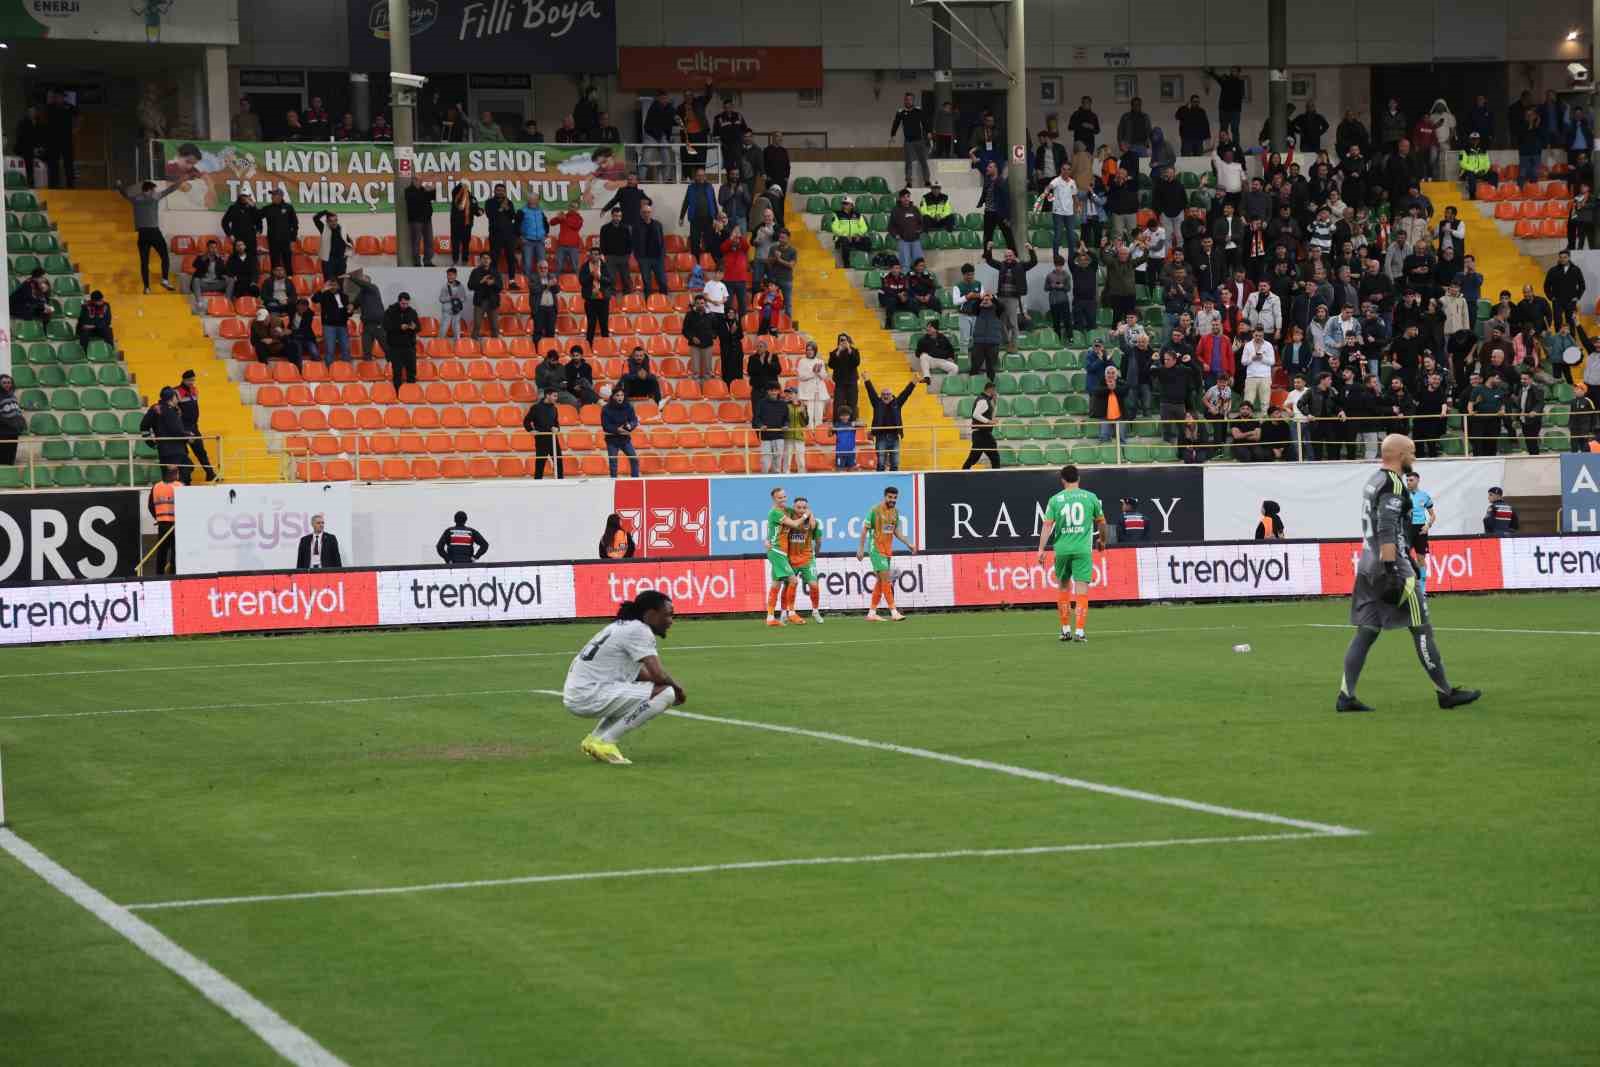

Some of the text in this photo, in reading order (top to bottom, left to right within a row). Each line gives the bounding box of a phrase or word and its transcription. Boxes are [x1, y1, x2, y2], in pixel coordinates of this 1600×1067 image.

[459, 0, 601, 40] Filli Boya
[265, 147, 339, 173] HAYDİ
[348, 150, 461, 173] ALAYAM
[469, 150, 546, 172] SENDE
[400, 159, 410, 171] B
[1015, 146, 1024, 159] C
[1060, 501, 1085, 527] 10
[1168, 551, 1290, 586] trendyol
[1534, 545, 1600, 574] tren
[207, 581, 345, 619] trendyol
[410, 574, 543, 612] trendyol
[608, 567, 736, 605] trendyol
[0, 589, 139, 631] trendyol
